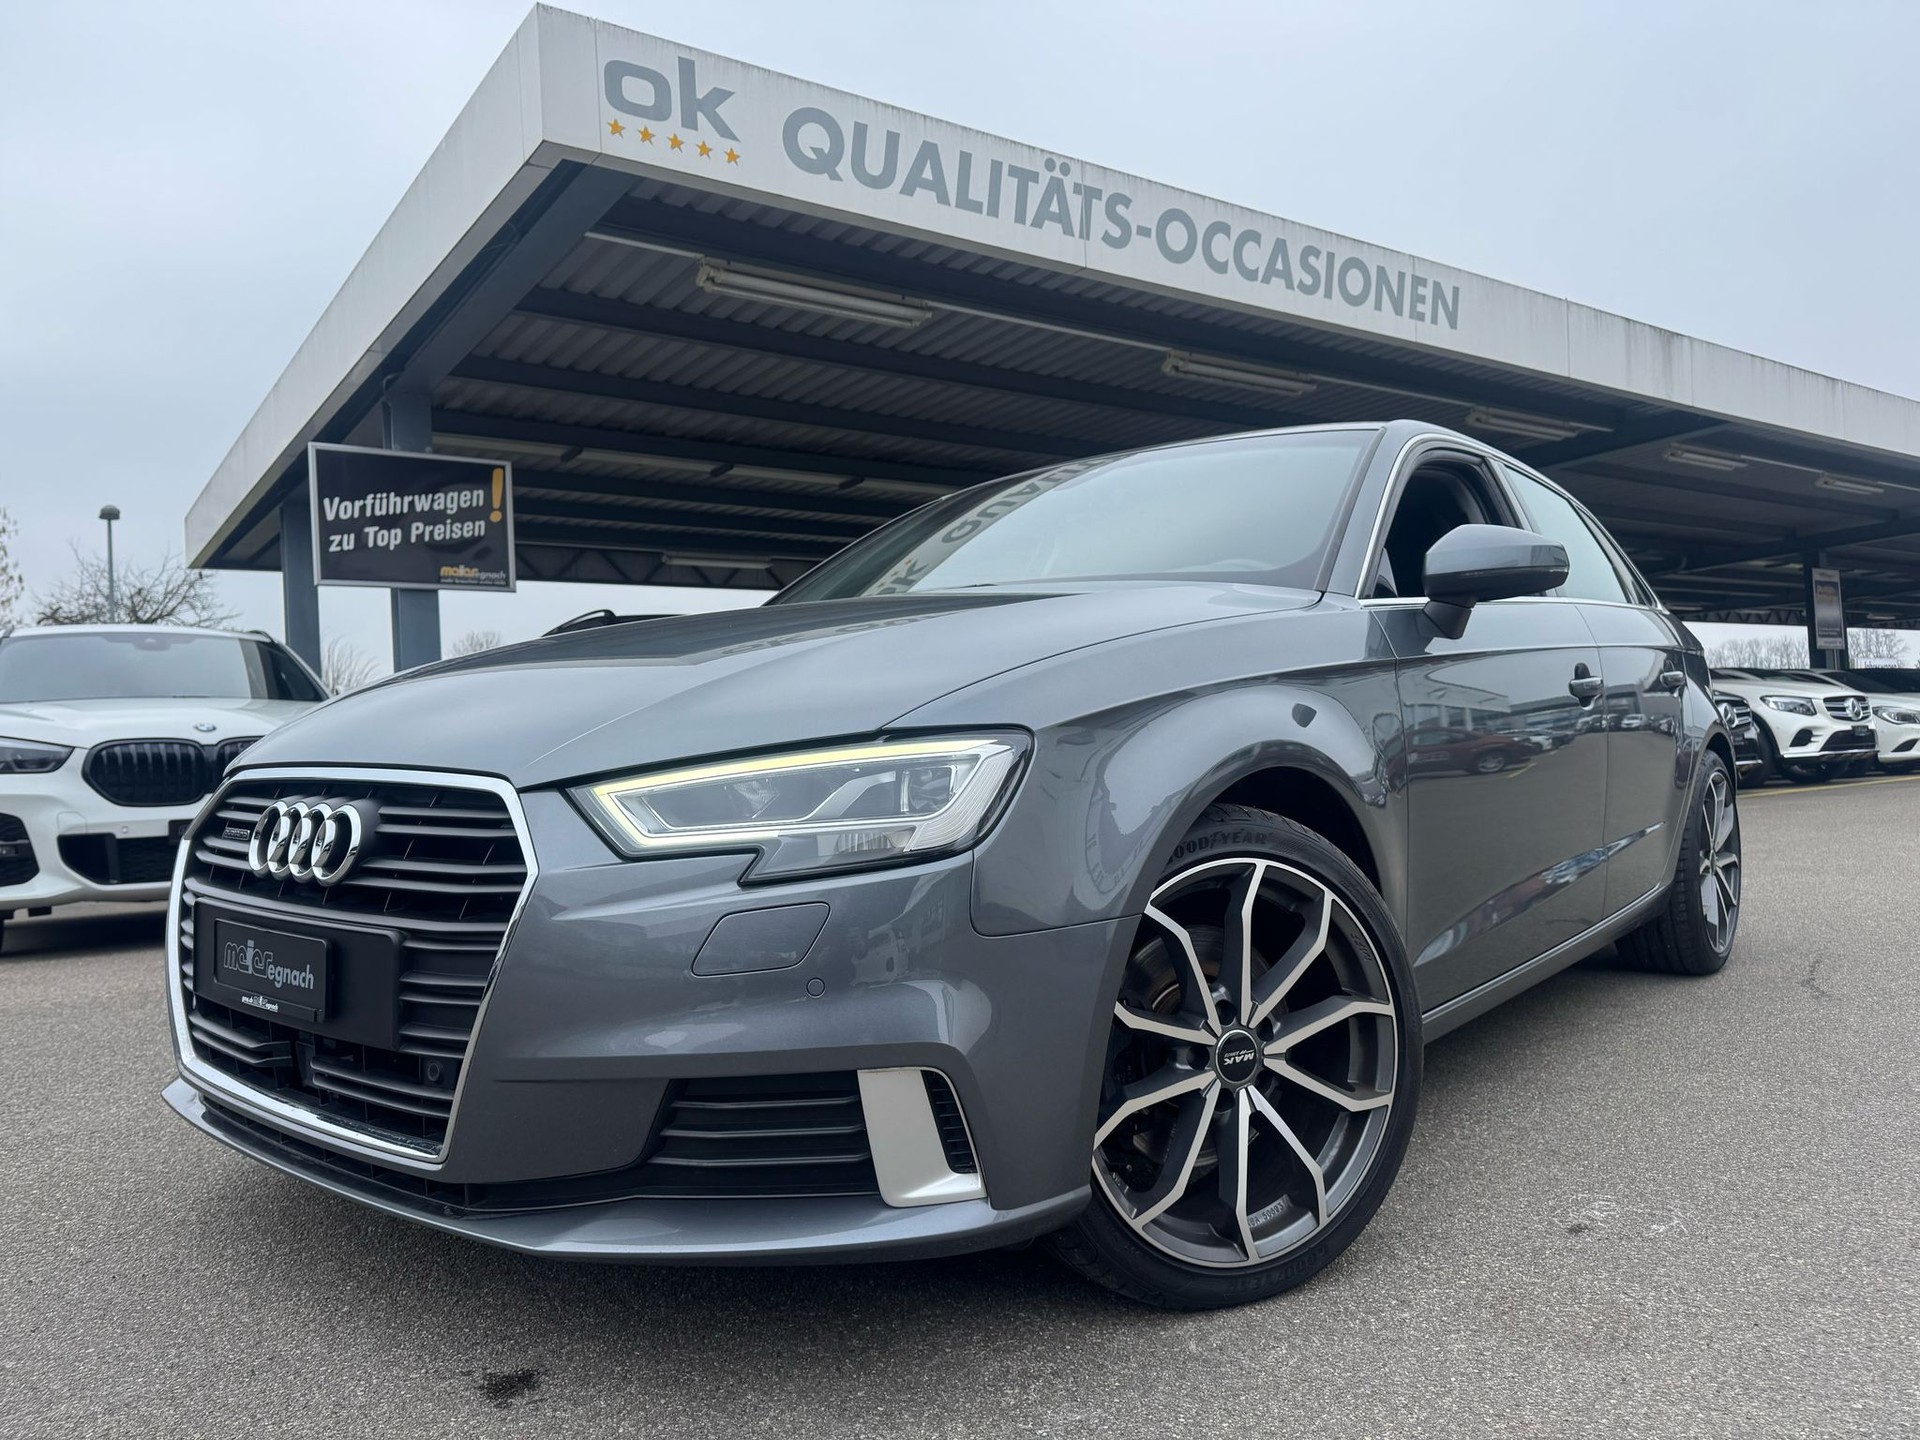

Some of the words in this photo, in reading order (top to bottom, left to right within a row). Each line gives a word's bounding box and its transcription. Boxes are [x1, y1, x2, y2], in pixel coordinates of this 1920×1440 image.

[604, 56, 740, 142] ok
[782, 107, 1460, 330] QUALITÄTS-OCCASIONEN
[323, 489, 484, 521] Vorführwagen
[328, 532, 355, 552] zu
[364, 526, 402, 550] Top
[410, 519, 486, 543] Preisen
[1223, 1052, 1255, 1066] MAK
